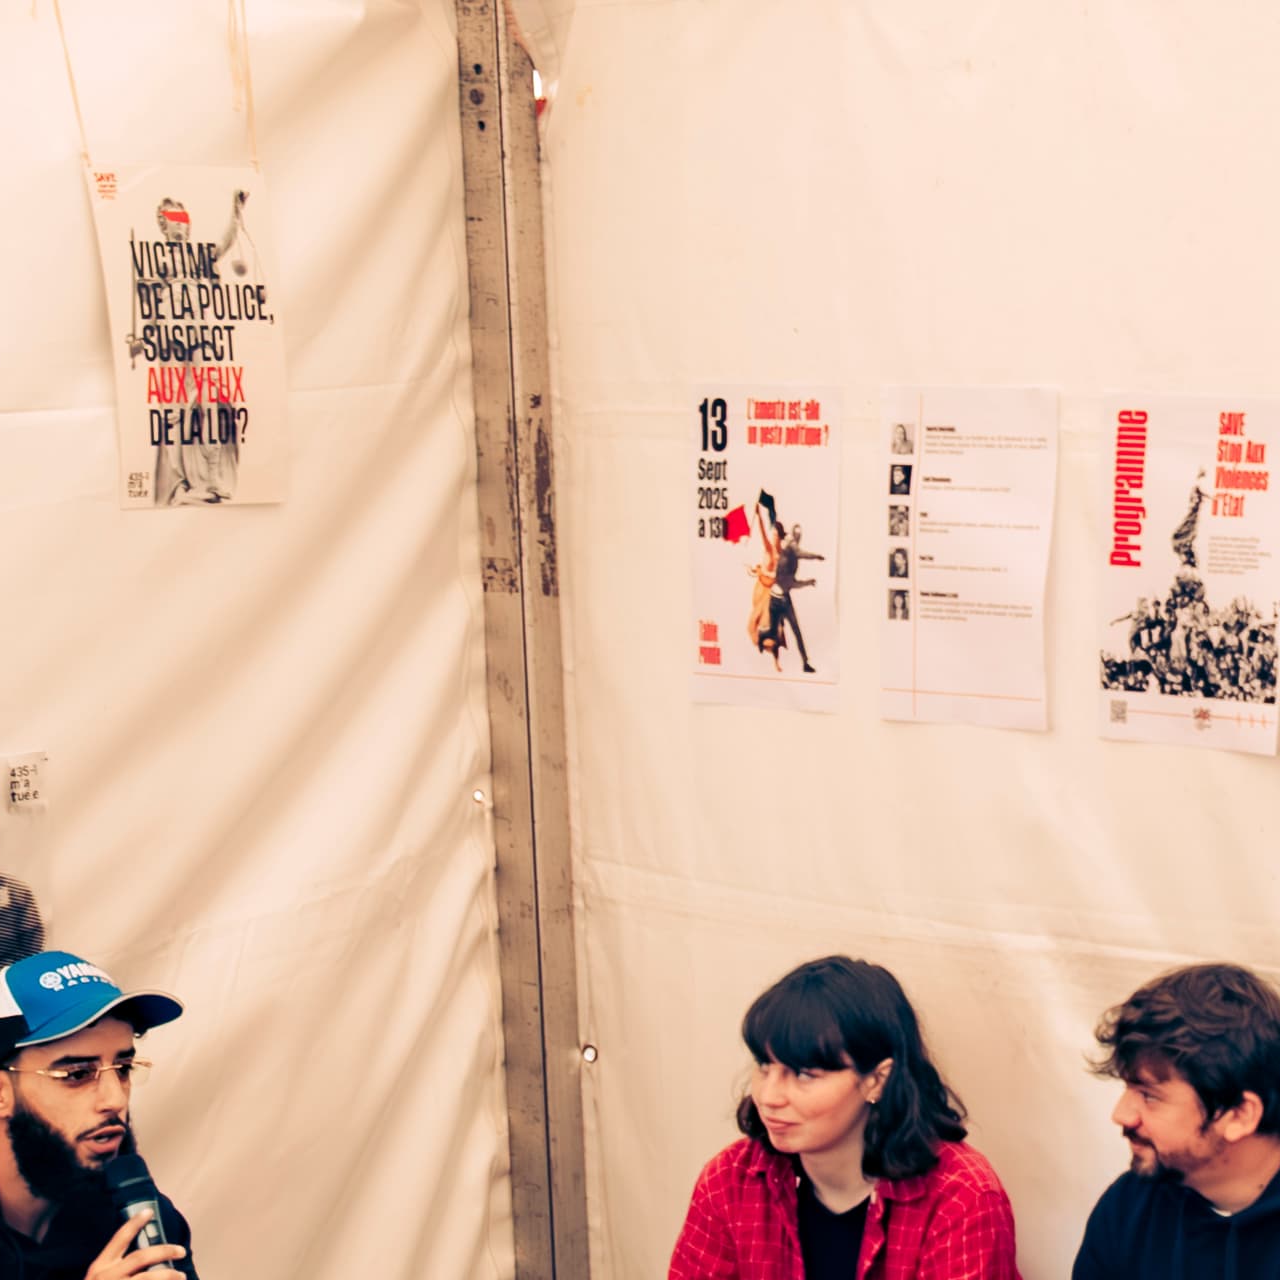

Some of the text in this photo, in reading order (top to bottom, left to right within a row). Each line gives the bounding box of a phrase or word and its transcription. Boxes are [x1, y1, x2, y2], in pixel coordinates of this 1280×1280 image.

[130, 241, 220, 279] VICTIME
[138, 283, 274, 324] DE LA POLICE,
[142, 325, 235, 362] SUSPECT
[147, 366, 246, 404] AUX YEUX
[149, 407, 248, 446] DE LA LOI?
[699, 398, 728, 452] 13
[1219, 412, 1246, 436] SAVE
[698, 458, 728, 482] Sept
[1109, 410, 1149, 567] Programme
[697, 487, 728, 510] 2025
